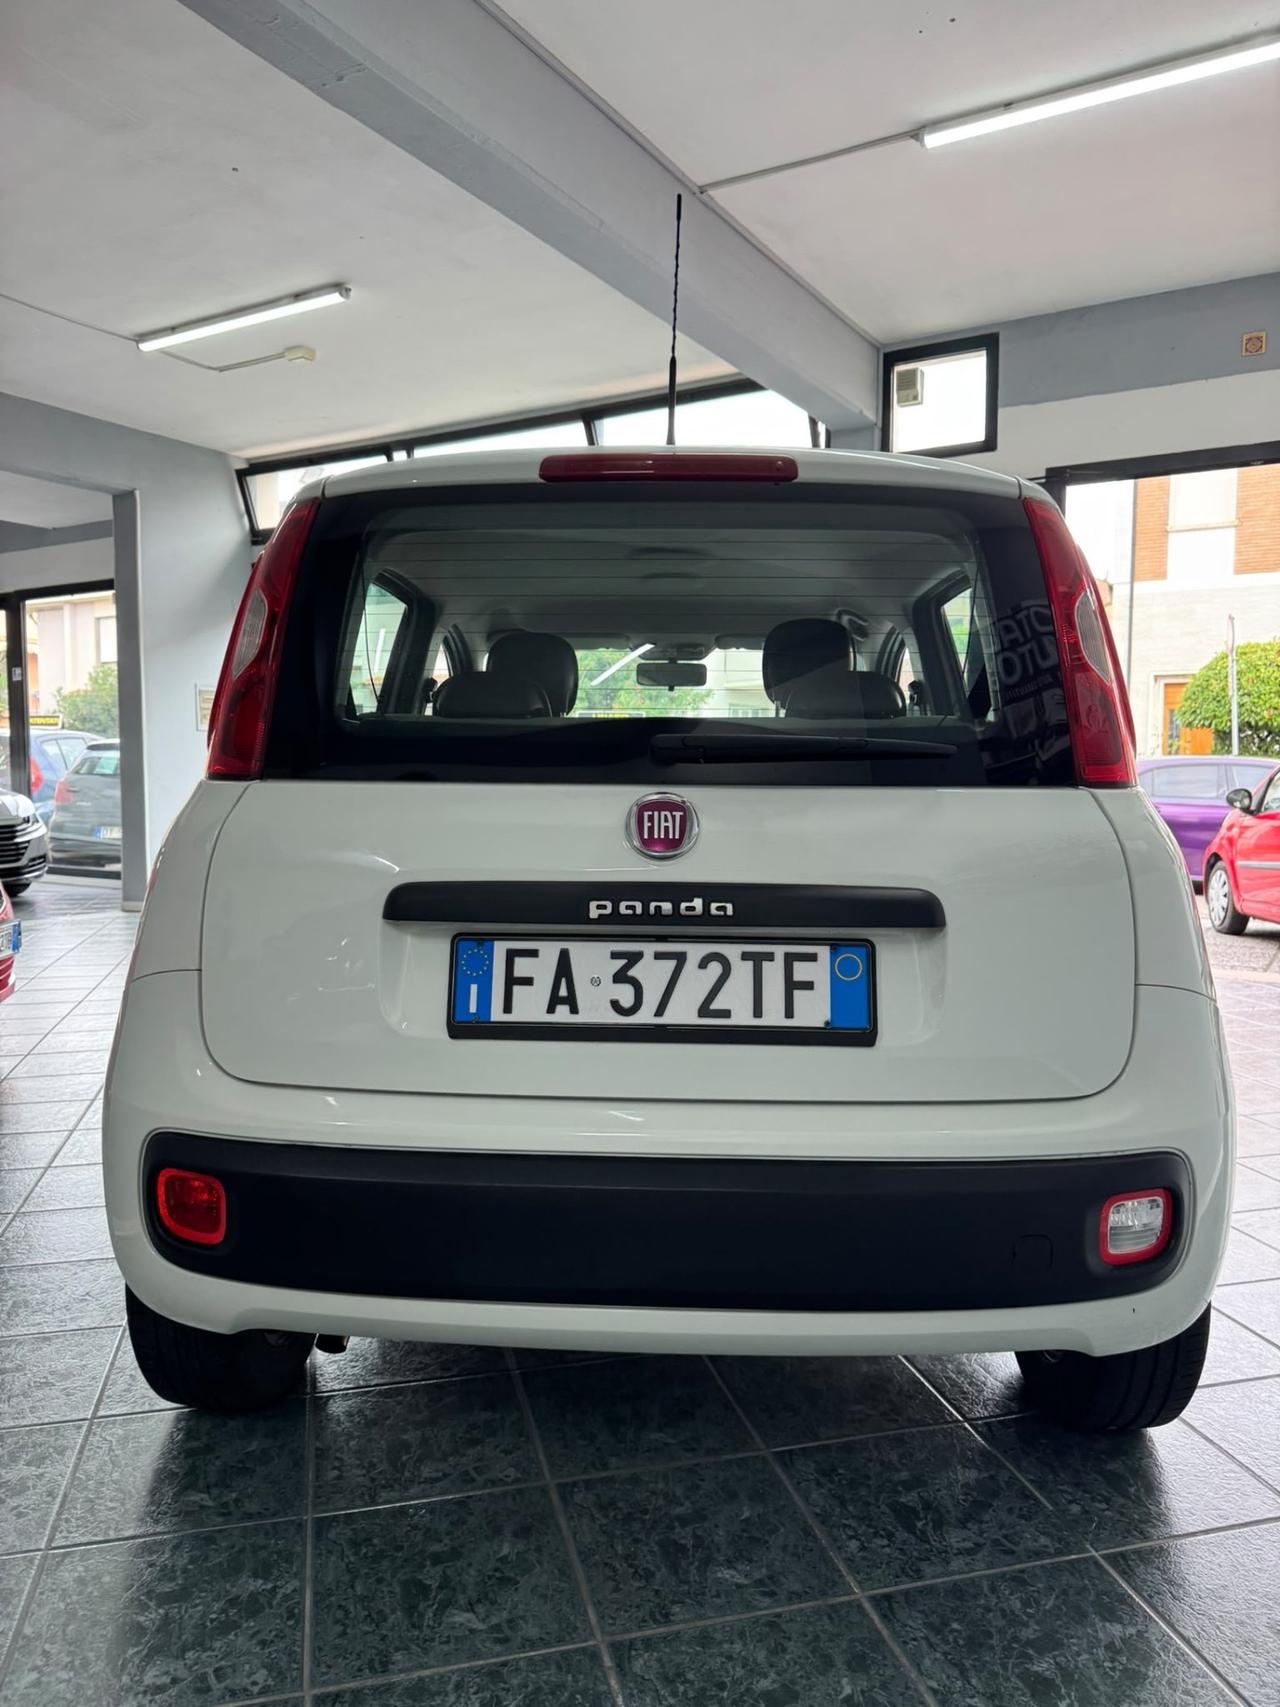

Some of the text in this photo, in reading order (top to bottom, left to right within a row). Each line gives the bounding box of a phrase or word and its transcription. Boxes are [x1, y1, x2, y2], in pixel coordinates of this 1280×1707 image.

[643, 810, 684, 839] FIAT
[589, 897, 735, 919] panda
[502, 948, 818, 1018] FA 372TF
